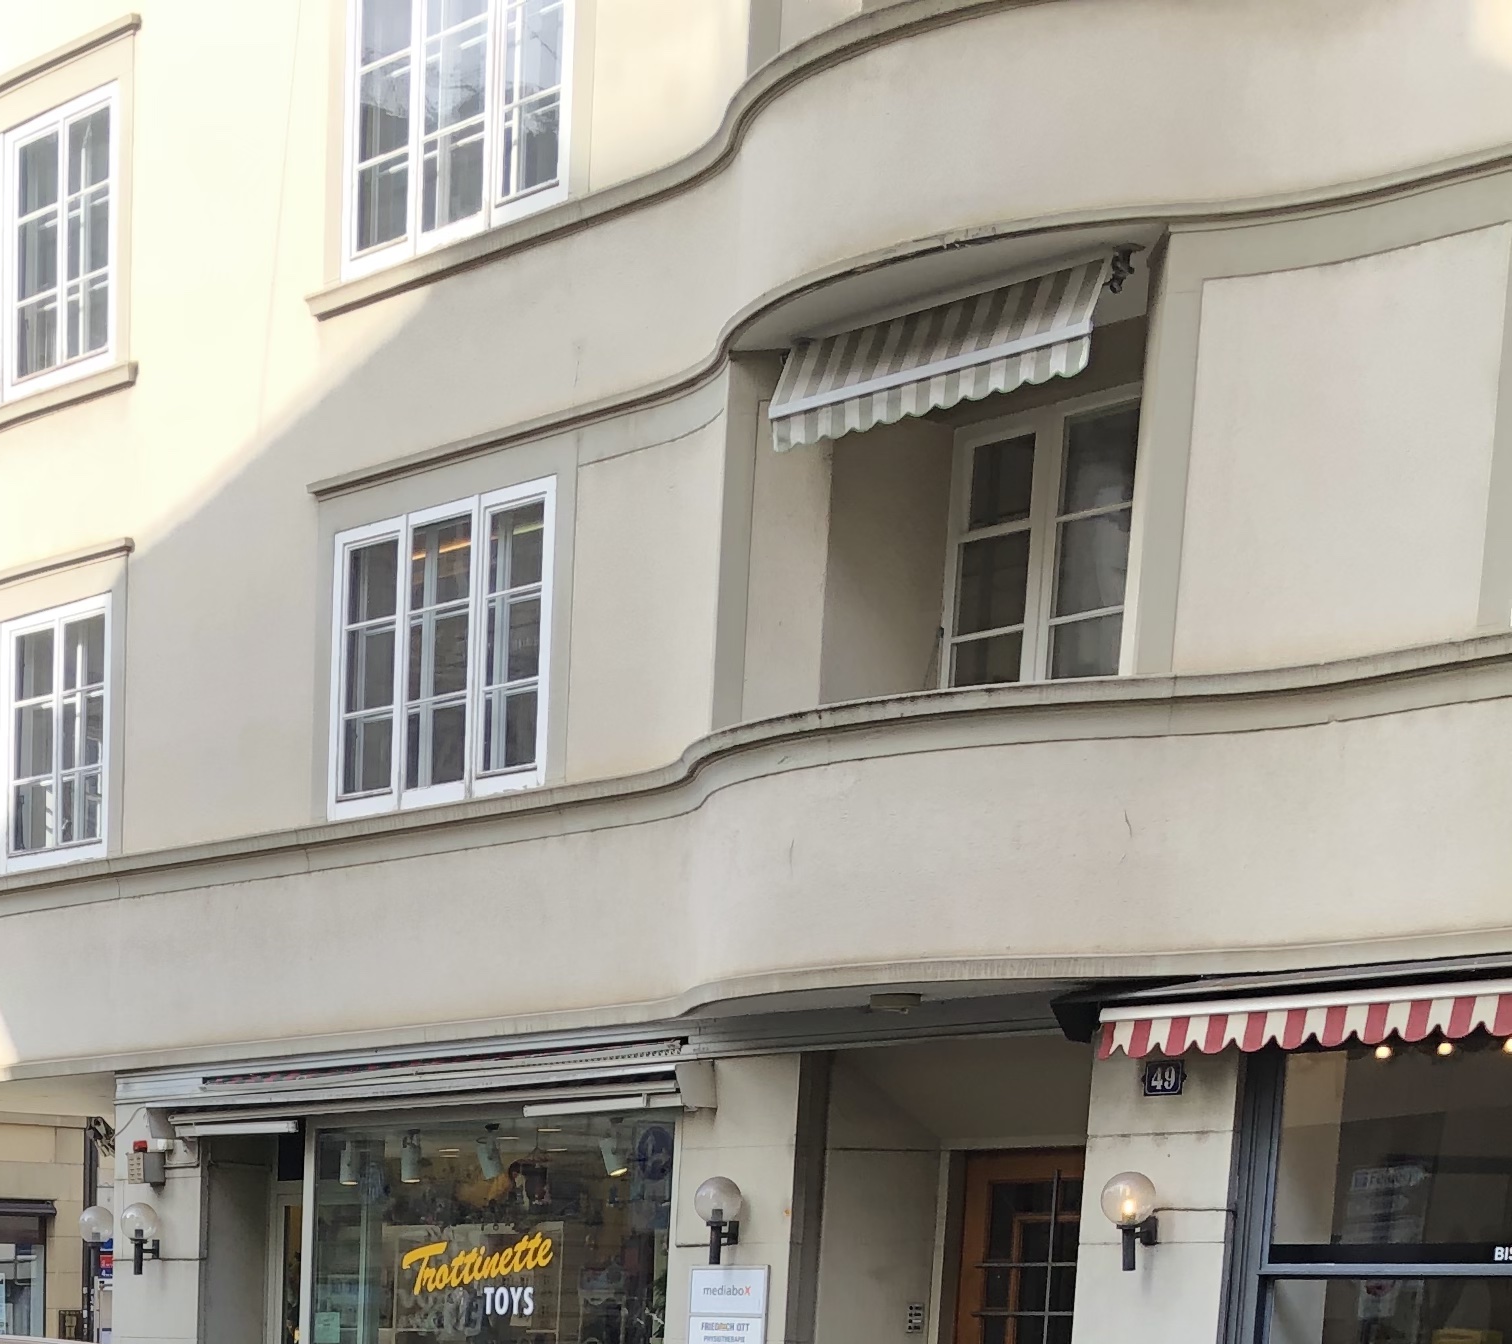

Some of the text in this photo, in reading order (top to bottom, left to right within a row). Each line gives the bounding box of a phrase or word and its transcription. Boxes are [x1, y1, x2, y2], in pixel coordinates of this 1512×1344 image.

[1151, 1066, 1176, 1089] 49
[402, 1232, 553, 1296] Trottinette
[484, 1286, 534, 1315] TOYS
